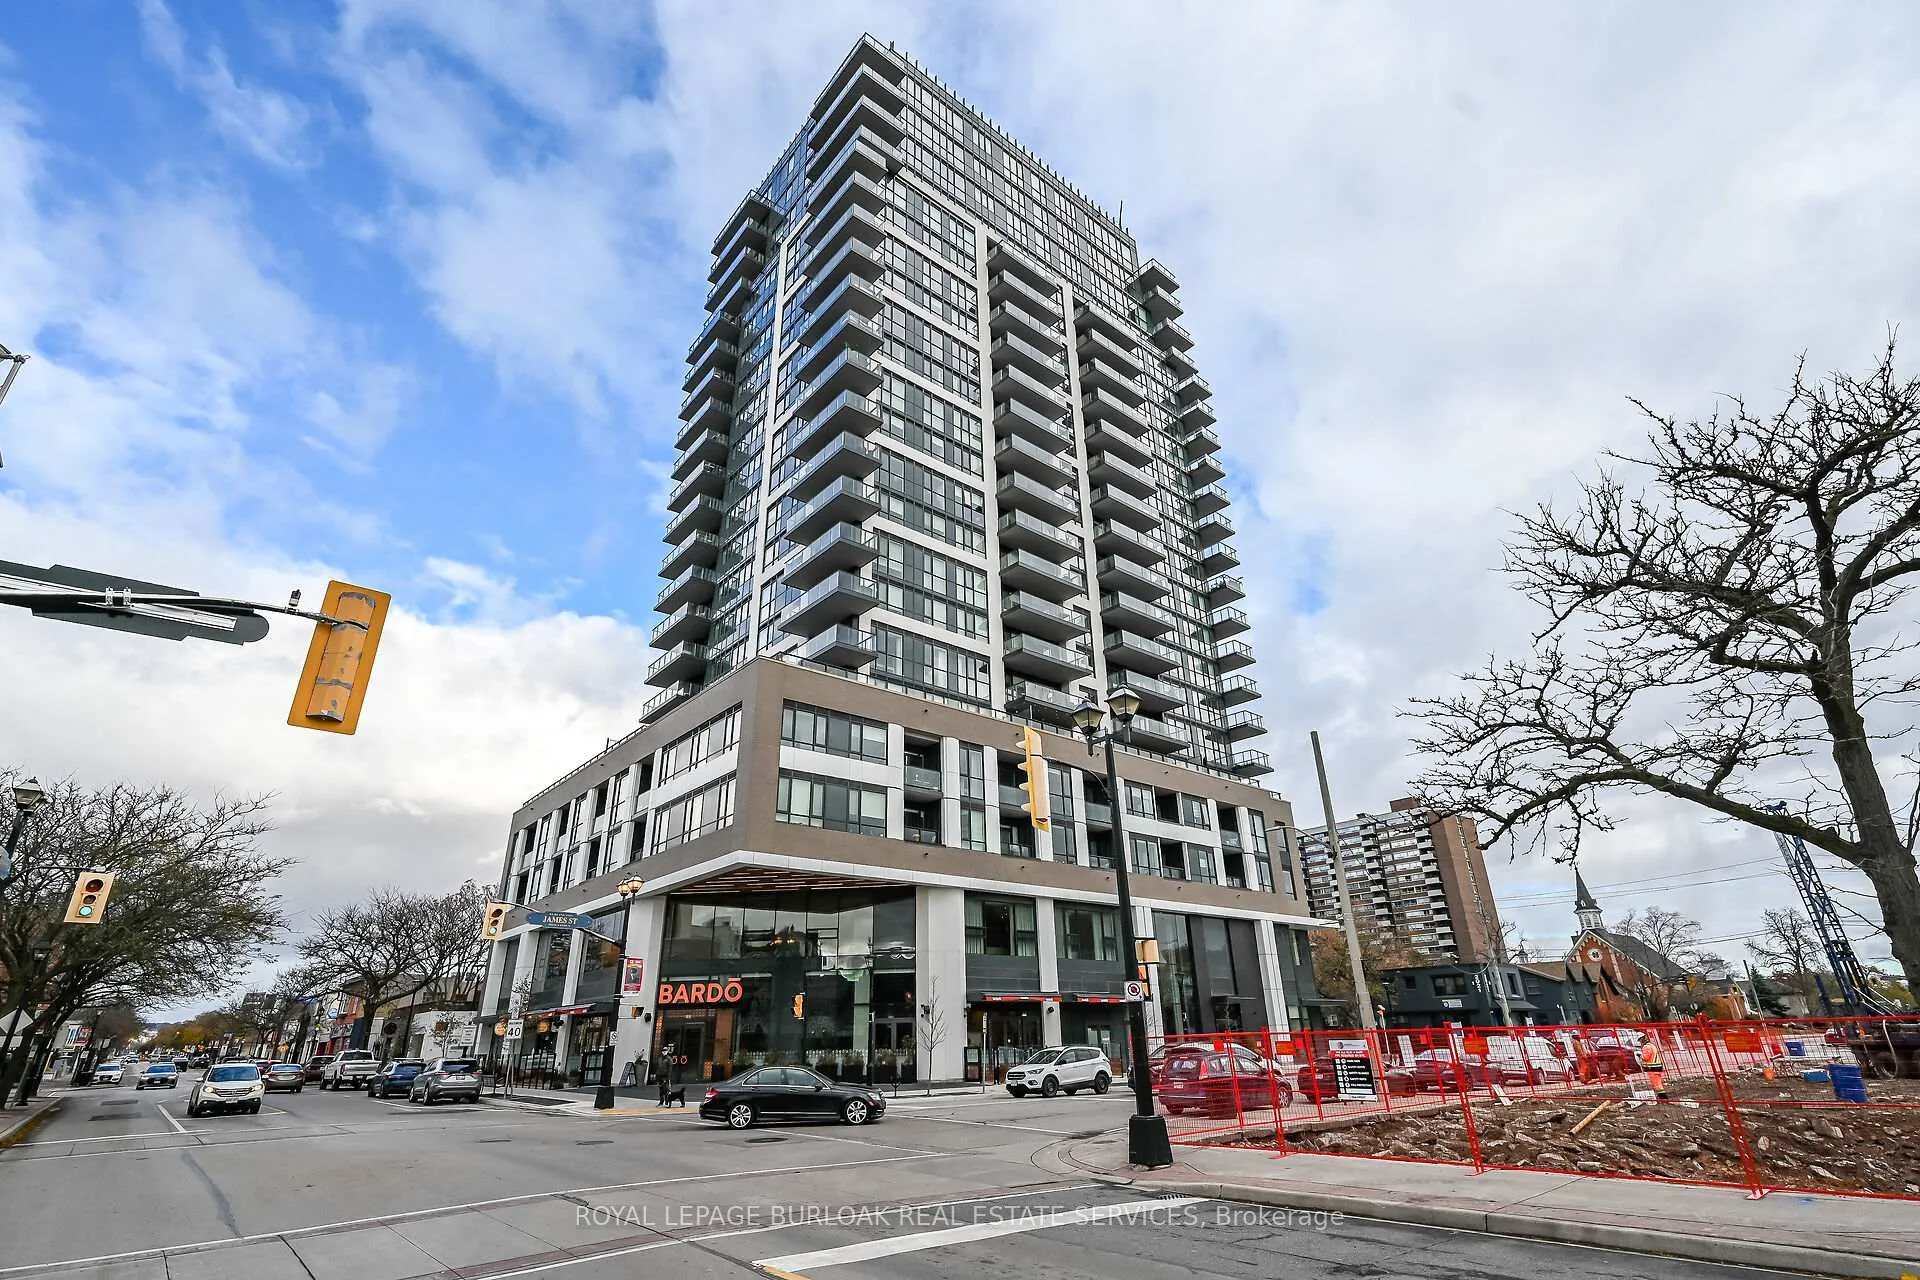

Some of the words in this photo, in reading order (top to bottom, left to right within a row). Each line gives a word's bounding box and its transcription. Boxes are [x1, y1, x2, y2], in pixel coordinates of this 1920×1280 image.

[543, 916, 567, 924] JAMES
[569, 917, 577, 925] ST
[508, 1027, 521, 1037] 40
